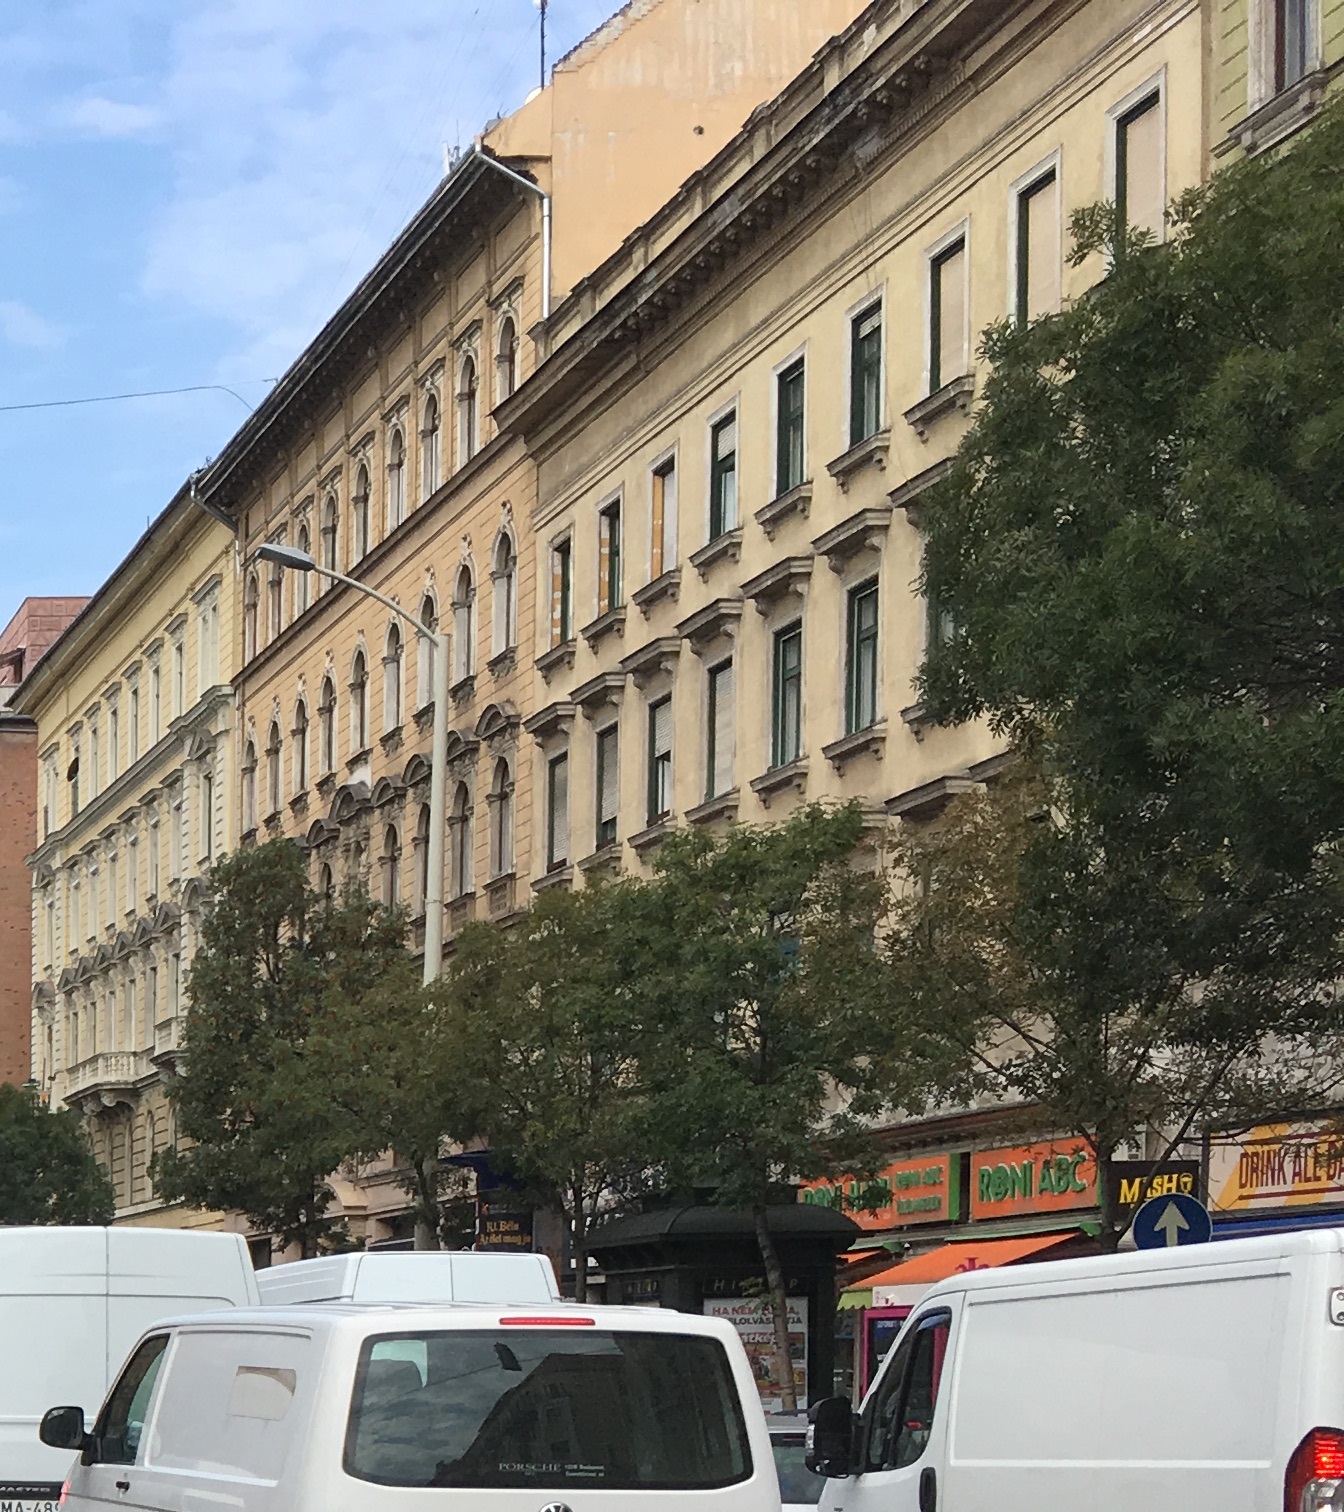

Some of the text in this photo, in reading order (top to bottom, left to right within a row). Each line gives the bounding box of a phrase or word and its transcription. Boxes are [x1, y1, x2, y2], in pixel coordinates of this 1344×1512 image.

[978, 1151, 1089, 1204] RONI ABC
[1238, 1148, 1288, 1189] DRINK
[1291, 1146, 1322, 1185] ALL
[1119, 1173, 1179, 1205] MSH
[712, 1306, 731, 1316] HA
[498, 1463, 562, 1472] PORSCHE
